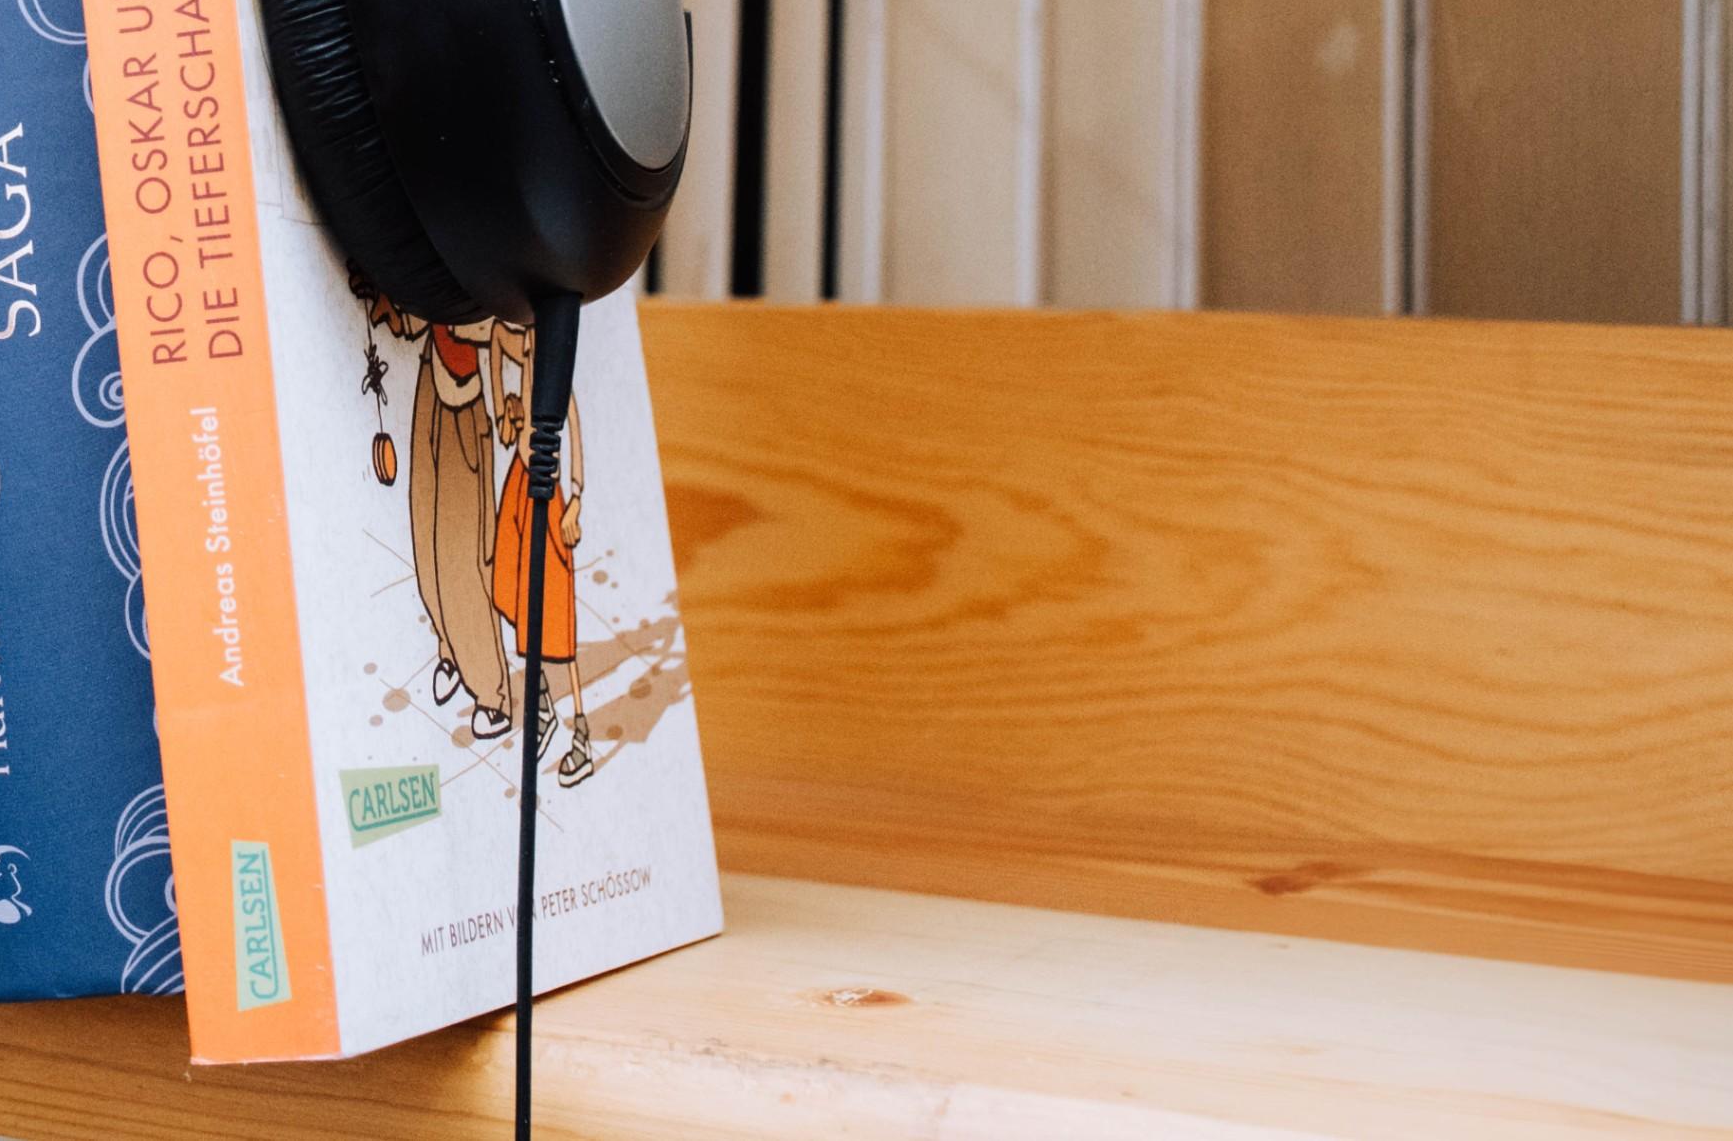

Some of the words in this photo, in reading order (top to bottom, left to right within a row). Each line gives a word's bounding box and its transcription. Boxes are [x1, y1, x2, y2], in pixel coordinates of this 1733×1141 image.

[123, 52, 172, 214] OSKAR
[142, 234, 188, 365] RICO,
[202, 287, 244, 359] DIE
[189, 406, 231, 552] Steinhöfel
[213, 563, 245, 687] Andreas
[348, 771, 439, 832] CARLSEN
[237, 849, 279, 1001] CARLSEN
[420, 926, 445, 956] MIT
[448, 910, 504, 948] BILDERN
[541, 887, 578, 920] PETER
[580, 865, 652, 907] SCHÖSSOW
